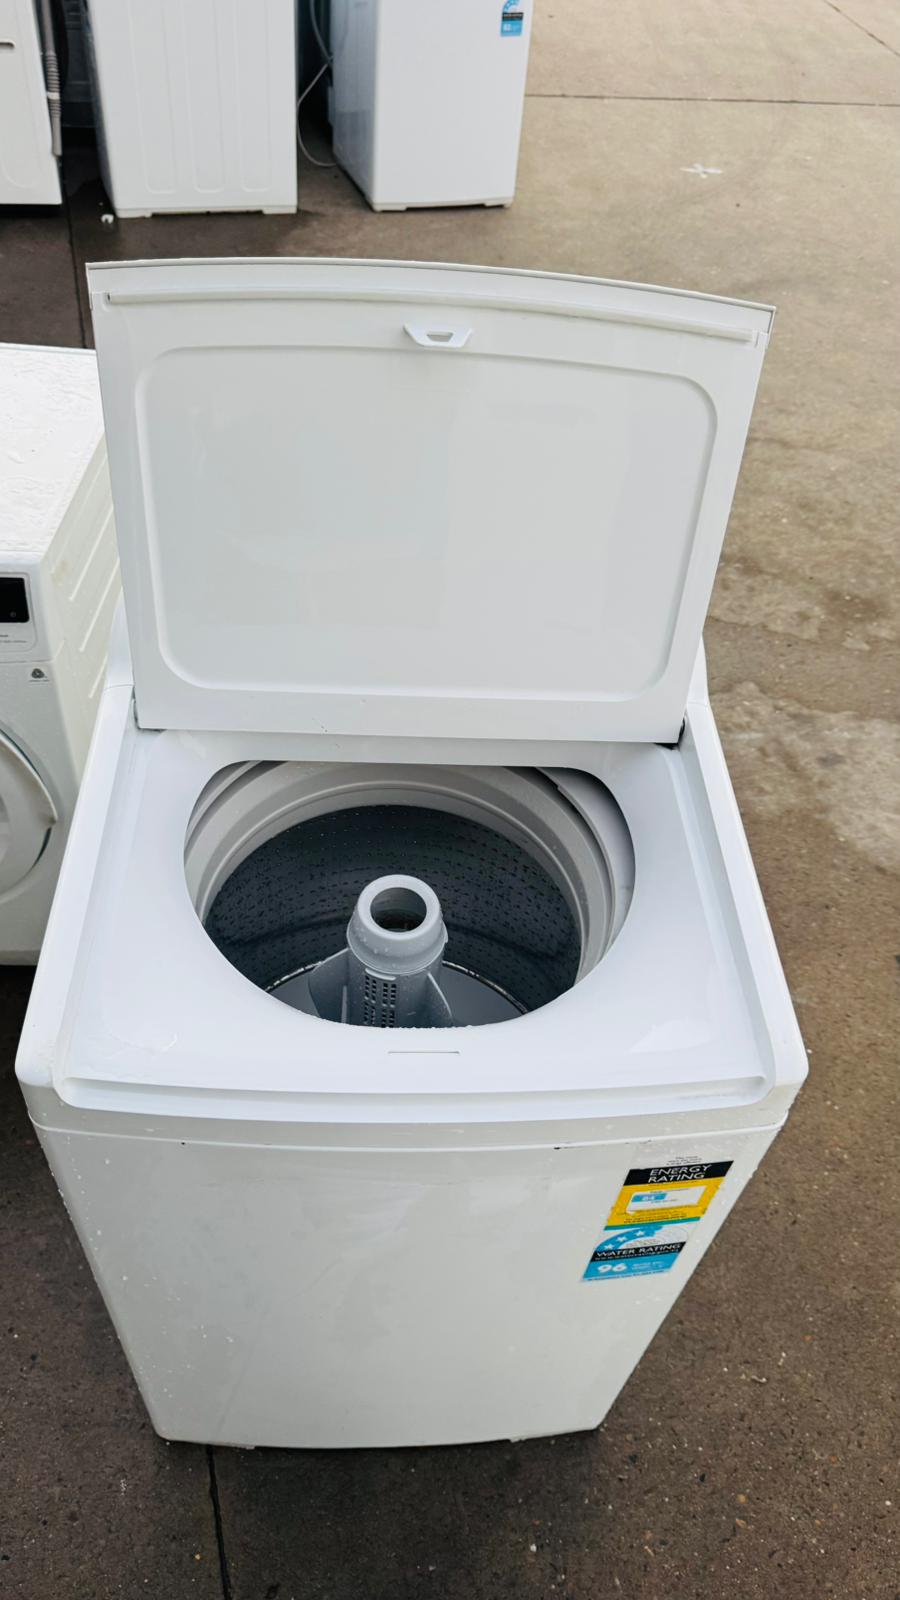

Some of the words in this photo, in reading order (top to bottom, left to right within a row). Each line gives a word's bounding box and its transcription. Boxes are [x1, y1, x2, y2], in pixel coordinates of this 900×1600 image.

[650, 1164, 712, 1176] ENERGY
[647, 1172, 705, 1183] RATING
[596, 1248, 635, 1257] WATER
[638, 1244, 681, 1253] RATING
[597, 1263, 628, 1273] 96
